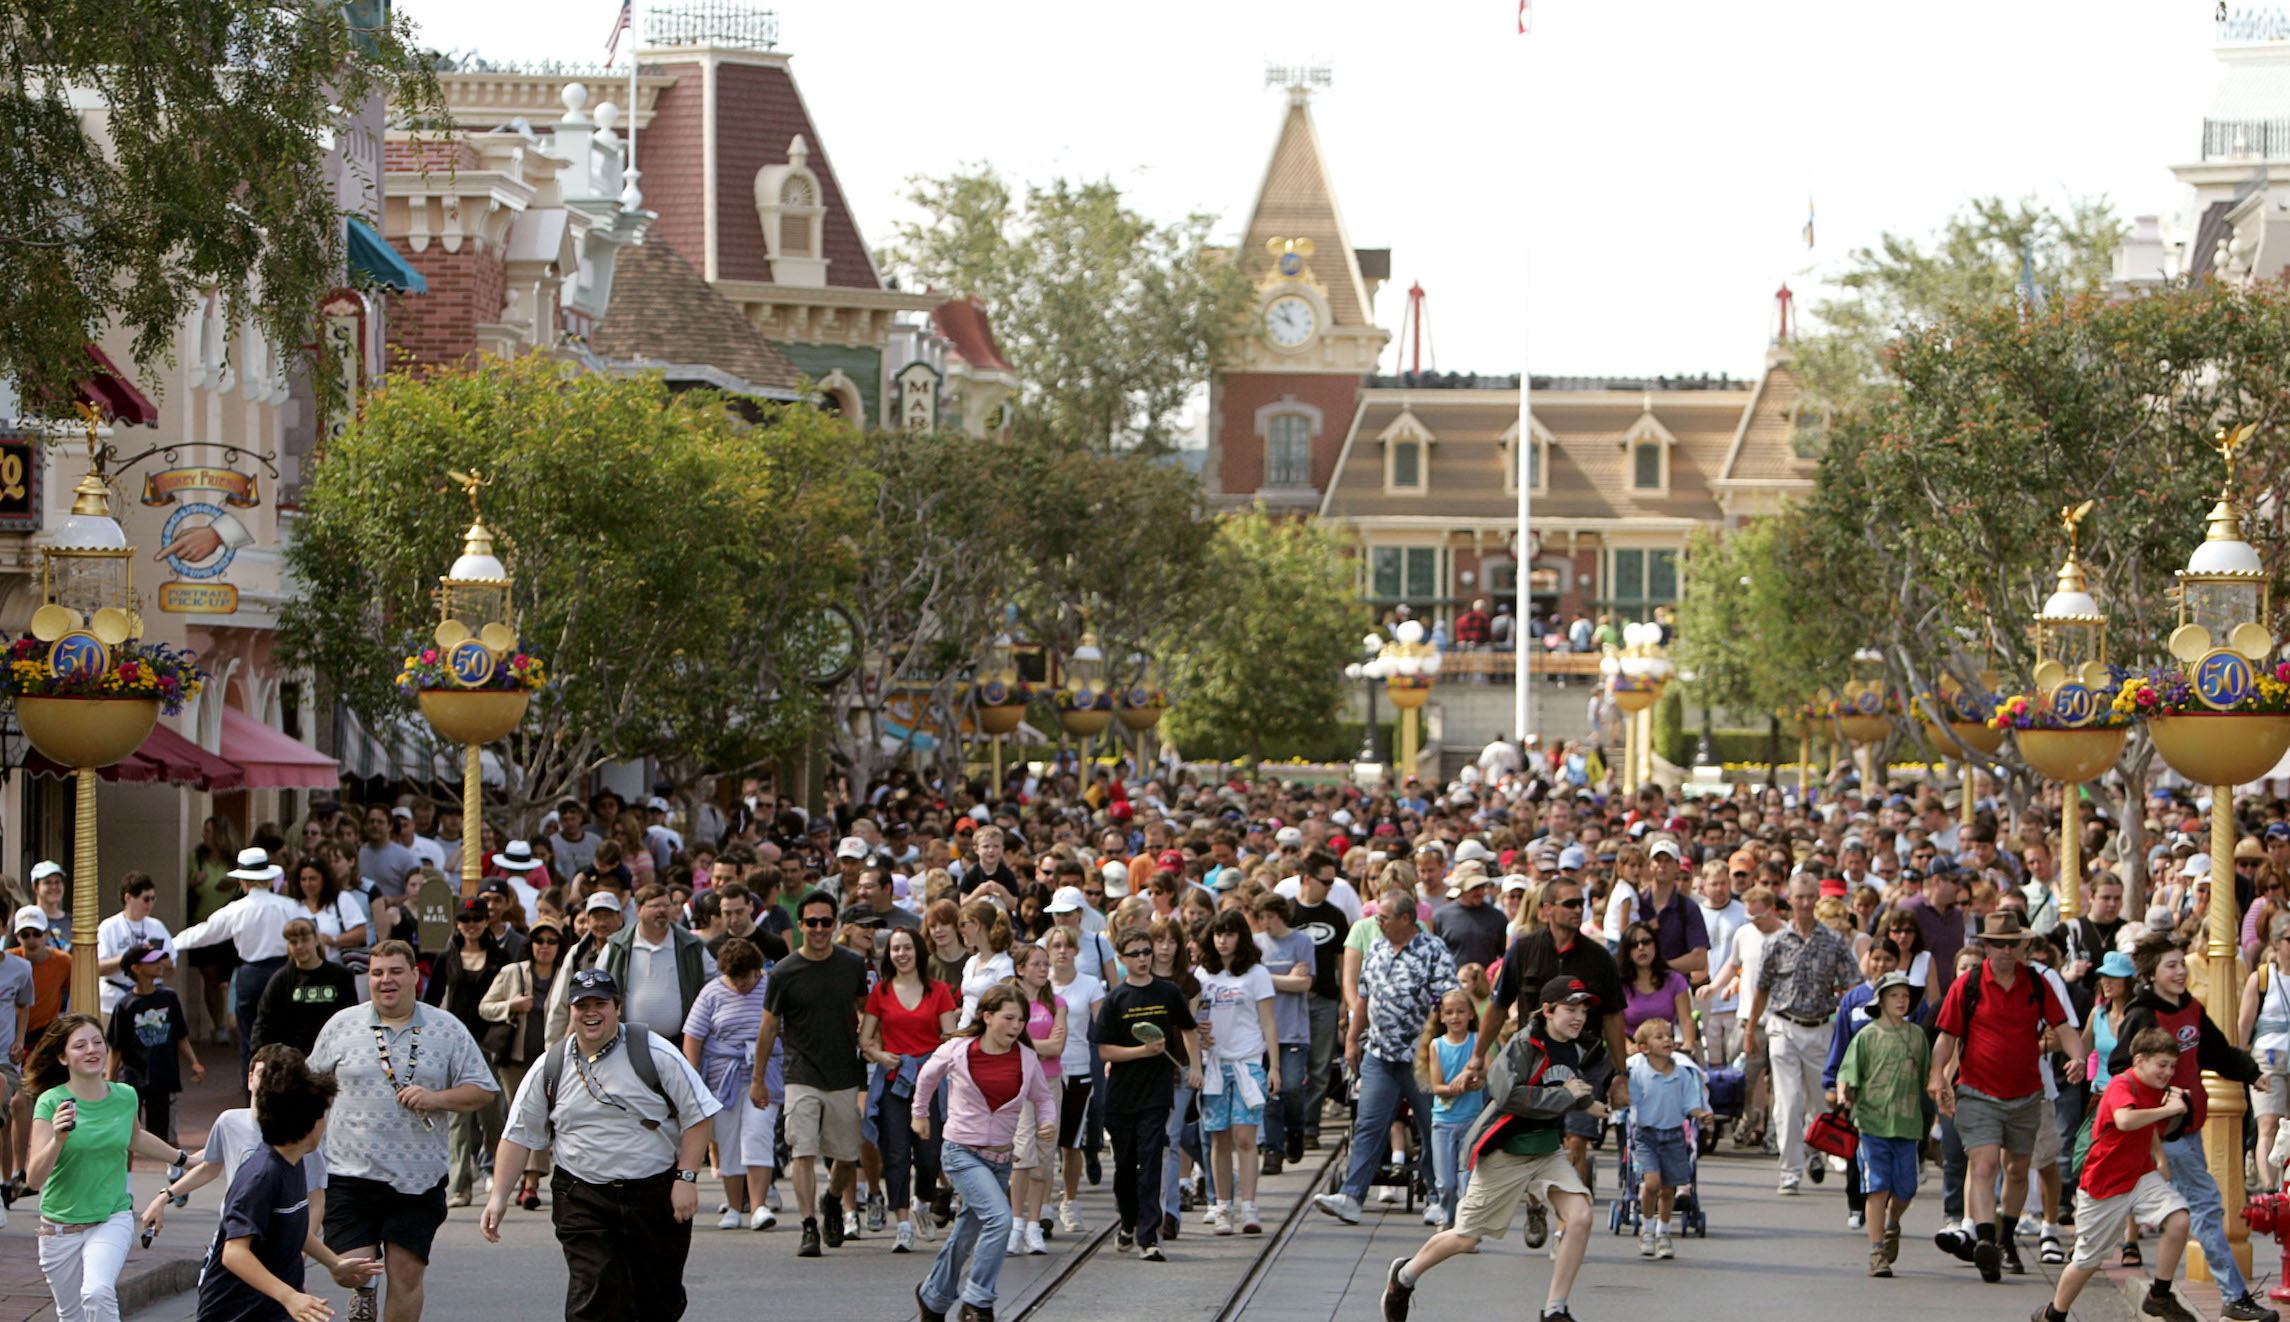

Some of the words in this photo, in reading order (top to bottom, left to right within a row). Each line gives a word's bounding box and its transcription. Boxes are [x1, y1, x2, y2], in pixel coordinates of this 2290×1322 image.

[58, 643, 101, 678] 50
[455, 649, 489, 678] 50
[2203, 661, 2246, 698] 50
[2057, 689, 2090, 717] 50
[423, 914, 449, 923] MAIL
